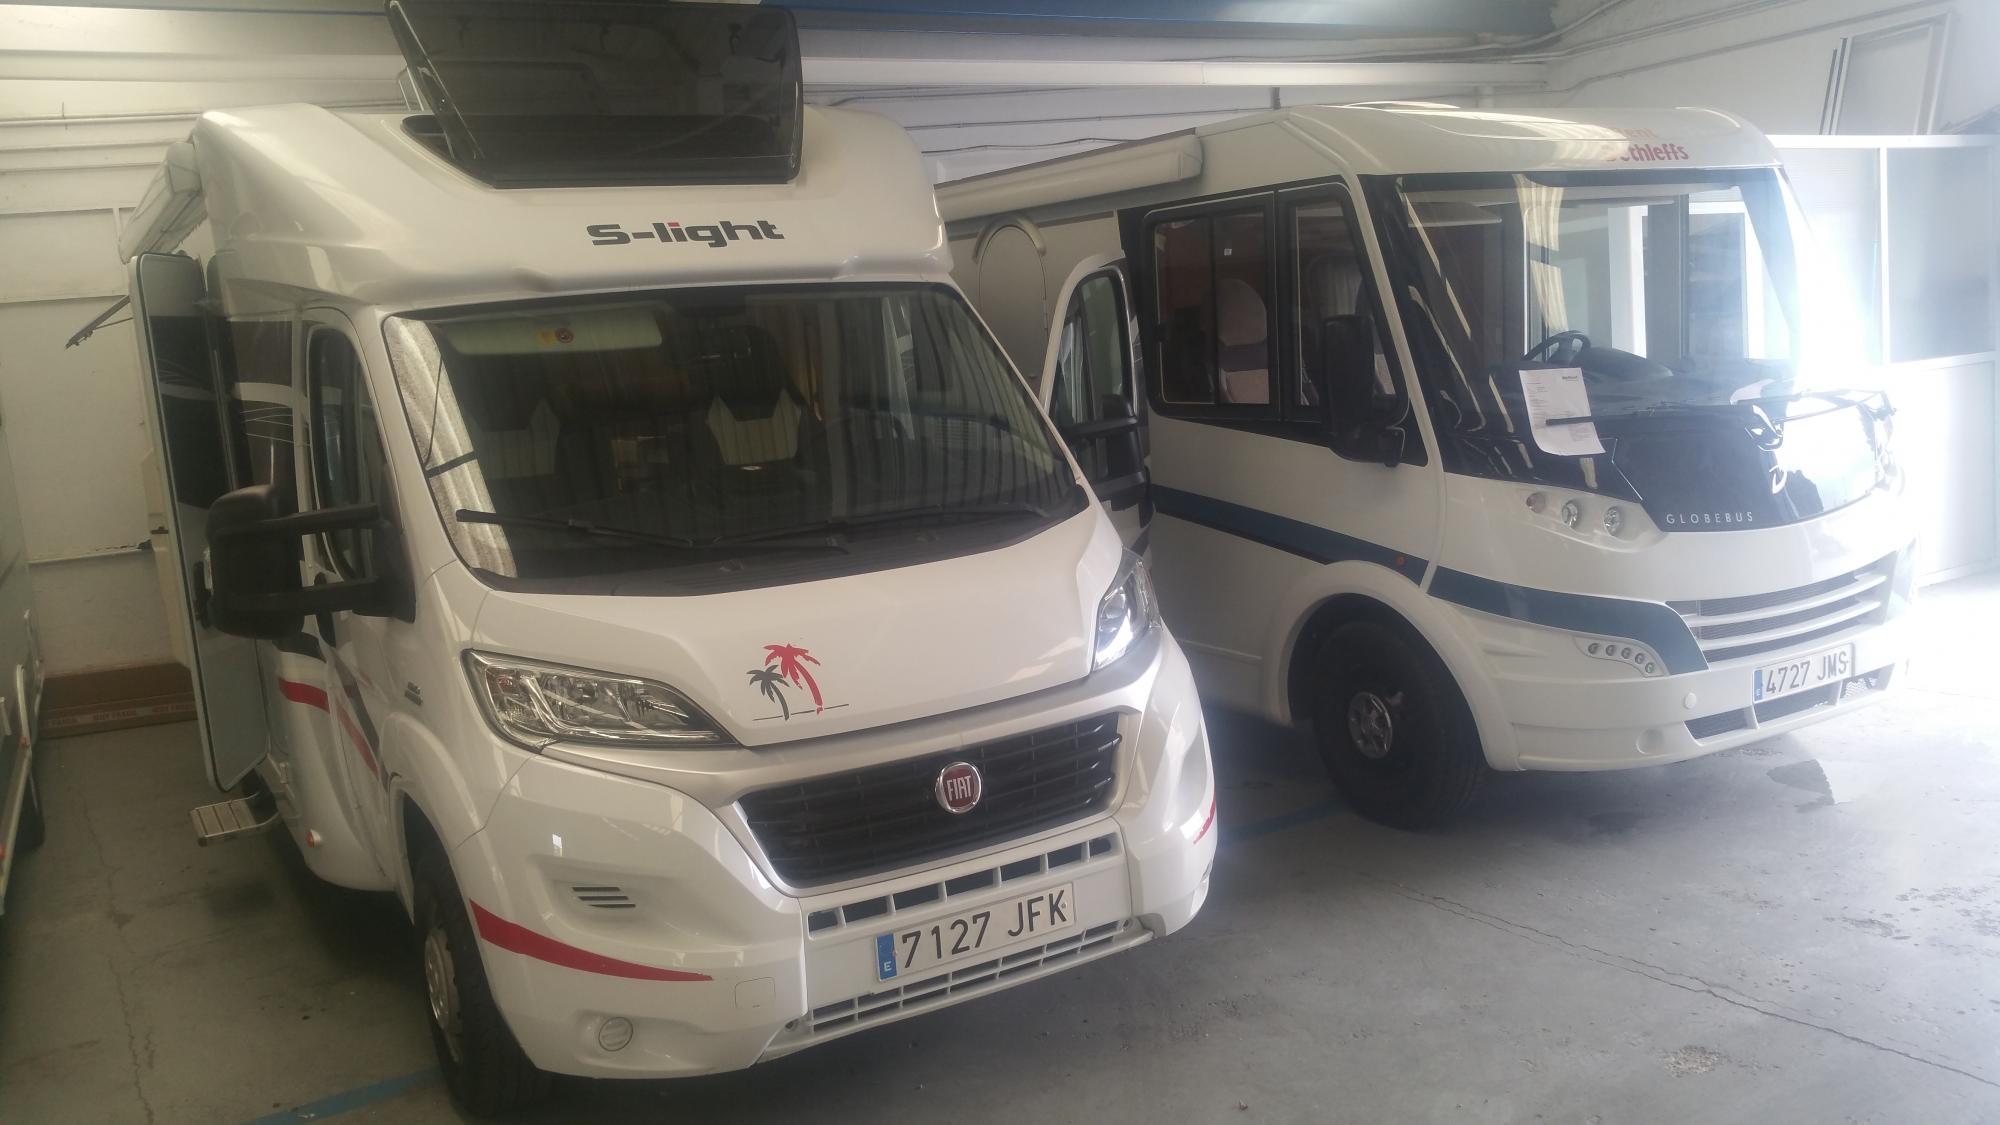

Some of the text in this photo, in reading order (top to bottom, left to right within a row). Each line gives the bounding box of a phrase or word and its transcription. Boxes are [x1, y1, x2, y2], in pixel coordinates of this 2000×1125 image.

[1603, 143, 1689, 161] thleffs
[586, 220, 785, 248] S-light
[1666, 512, 1753, 524] GLOBEBUS
[1766, 651, 1848, 693] 4727 JMS
[947, 776, 971, 801] FIAT
[902, 890, 1067, 969] 7127 JFK
[884, 961, 892, 971] E
